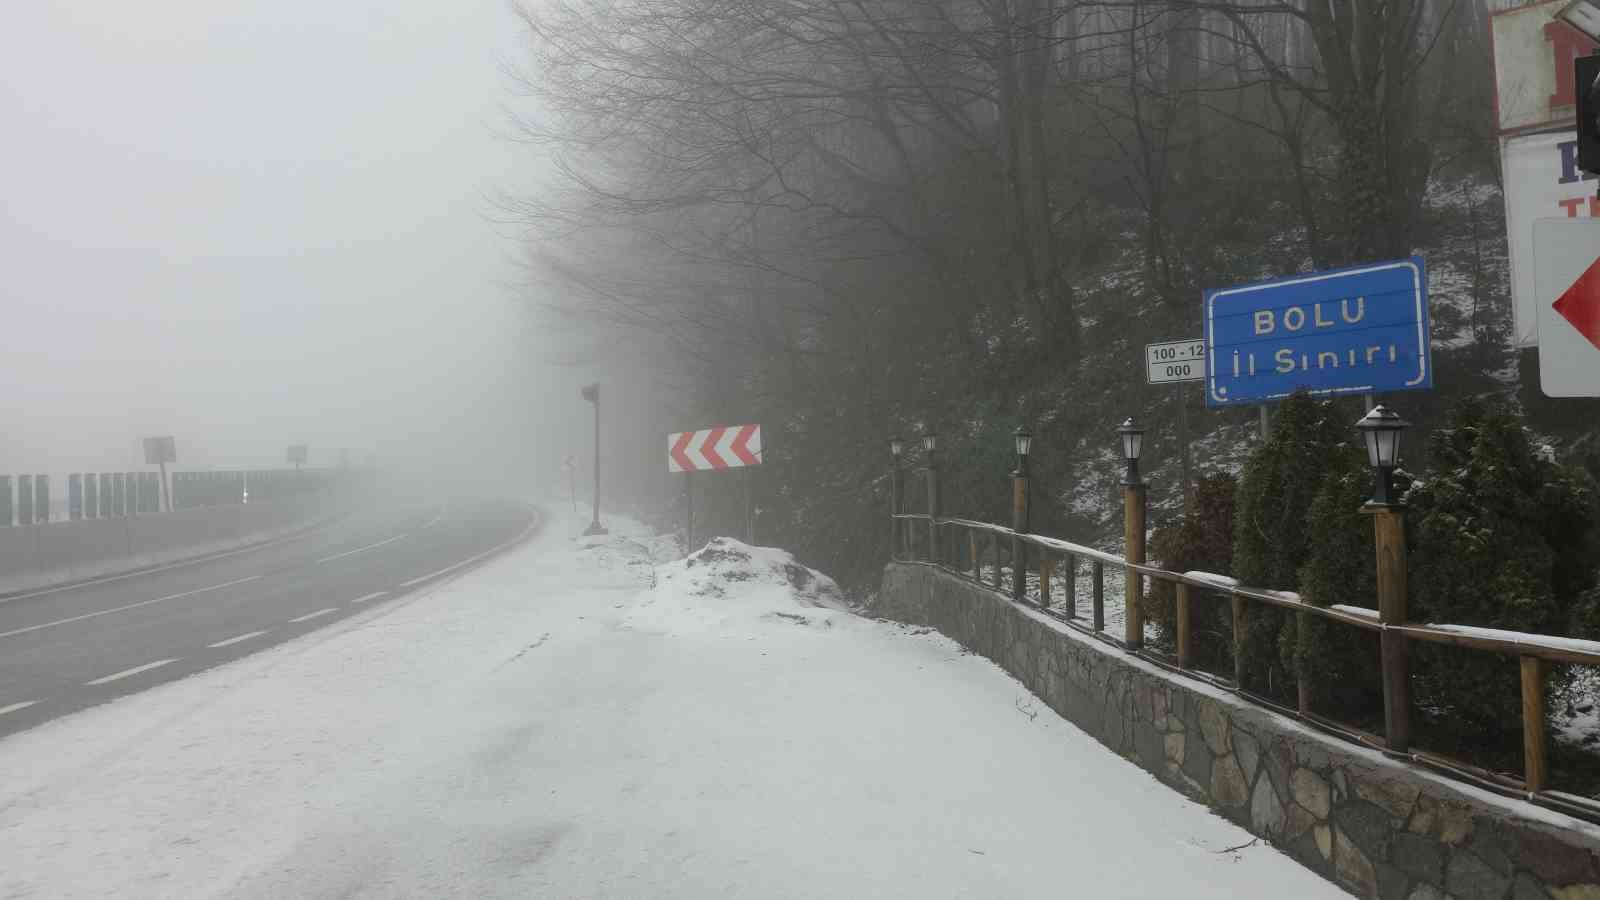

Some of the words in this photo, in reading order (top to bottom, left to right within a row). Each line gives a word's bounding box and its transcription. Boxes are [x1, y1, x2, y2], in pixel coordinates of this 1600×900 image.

[1254, 297, 1365, 335] BOLU
[1153, 347, 1176, 360] 100
[1189, 344, 1204, 356] 12
[1166, 365, 1191, 377] 000
